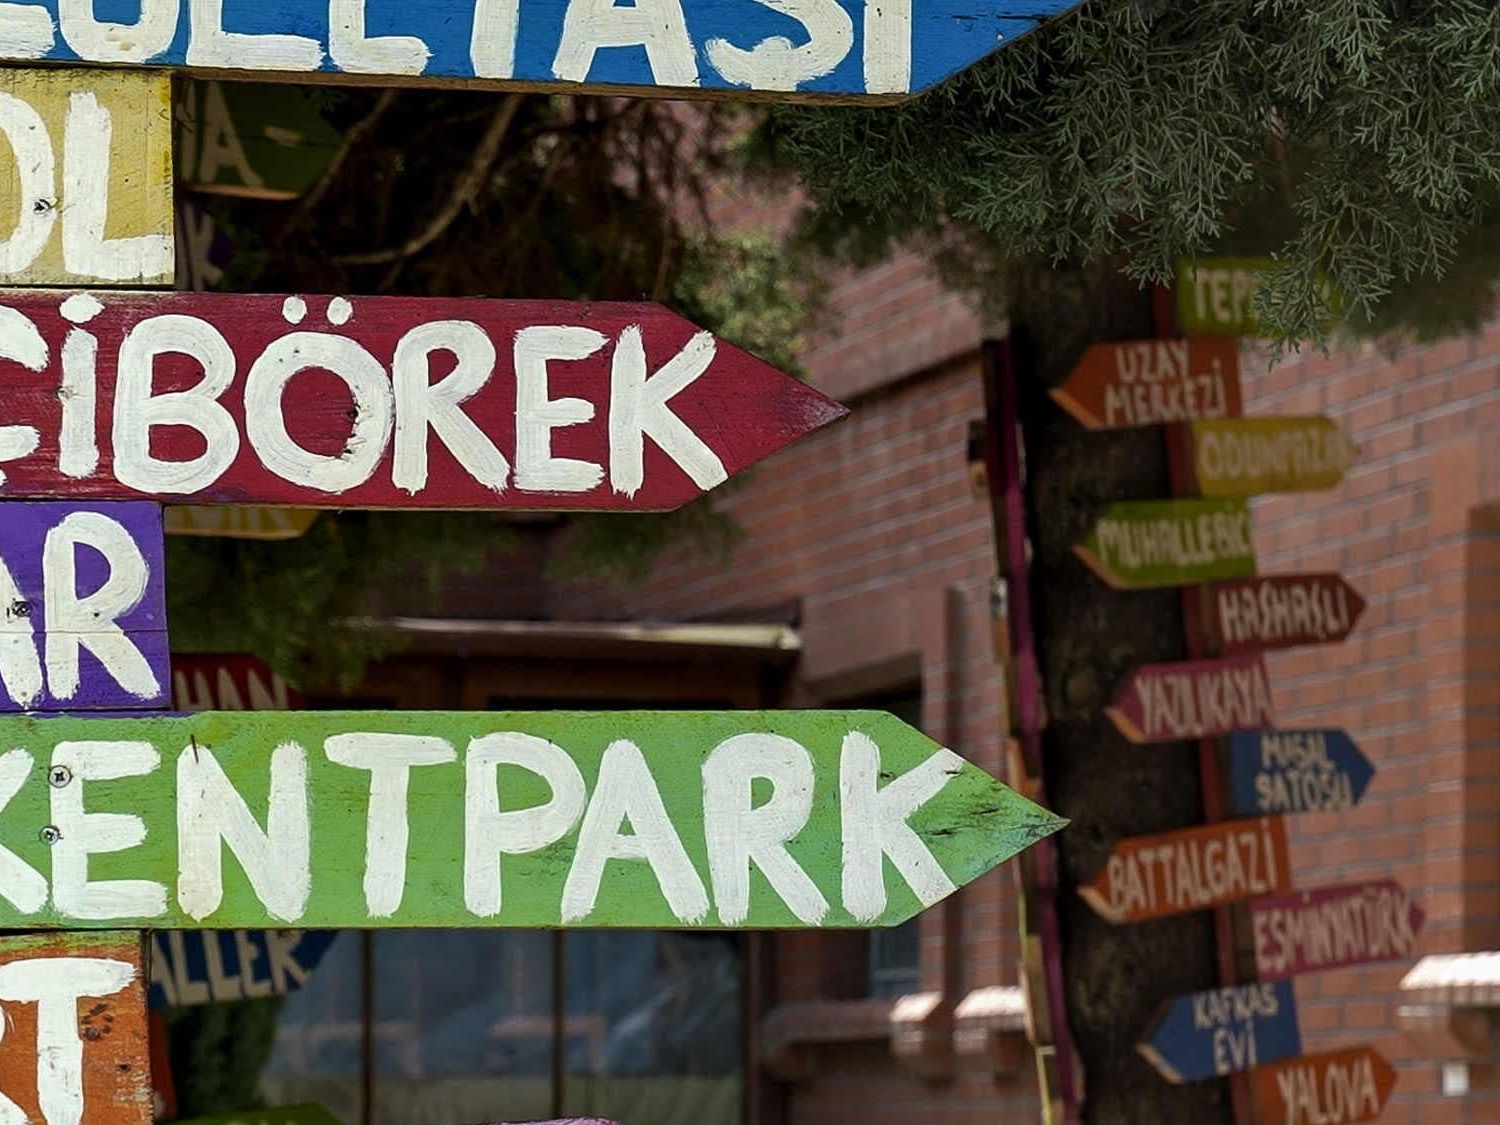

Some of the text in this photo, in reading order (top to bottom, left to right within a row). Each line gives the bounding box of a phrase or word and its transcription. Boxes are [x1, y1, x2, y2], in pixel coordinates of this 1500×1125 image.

[1116, 340, 1190, 383] UZAY
[1104, 357, 1227, 426] MERKEZİ
[1107, 817, 1277, 917] BATTALGAZİ
[1193, 981, 1279, 1028] KAFKAS
